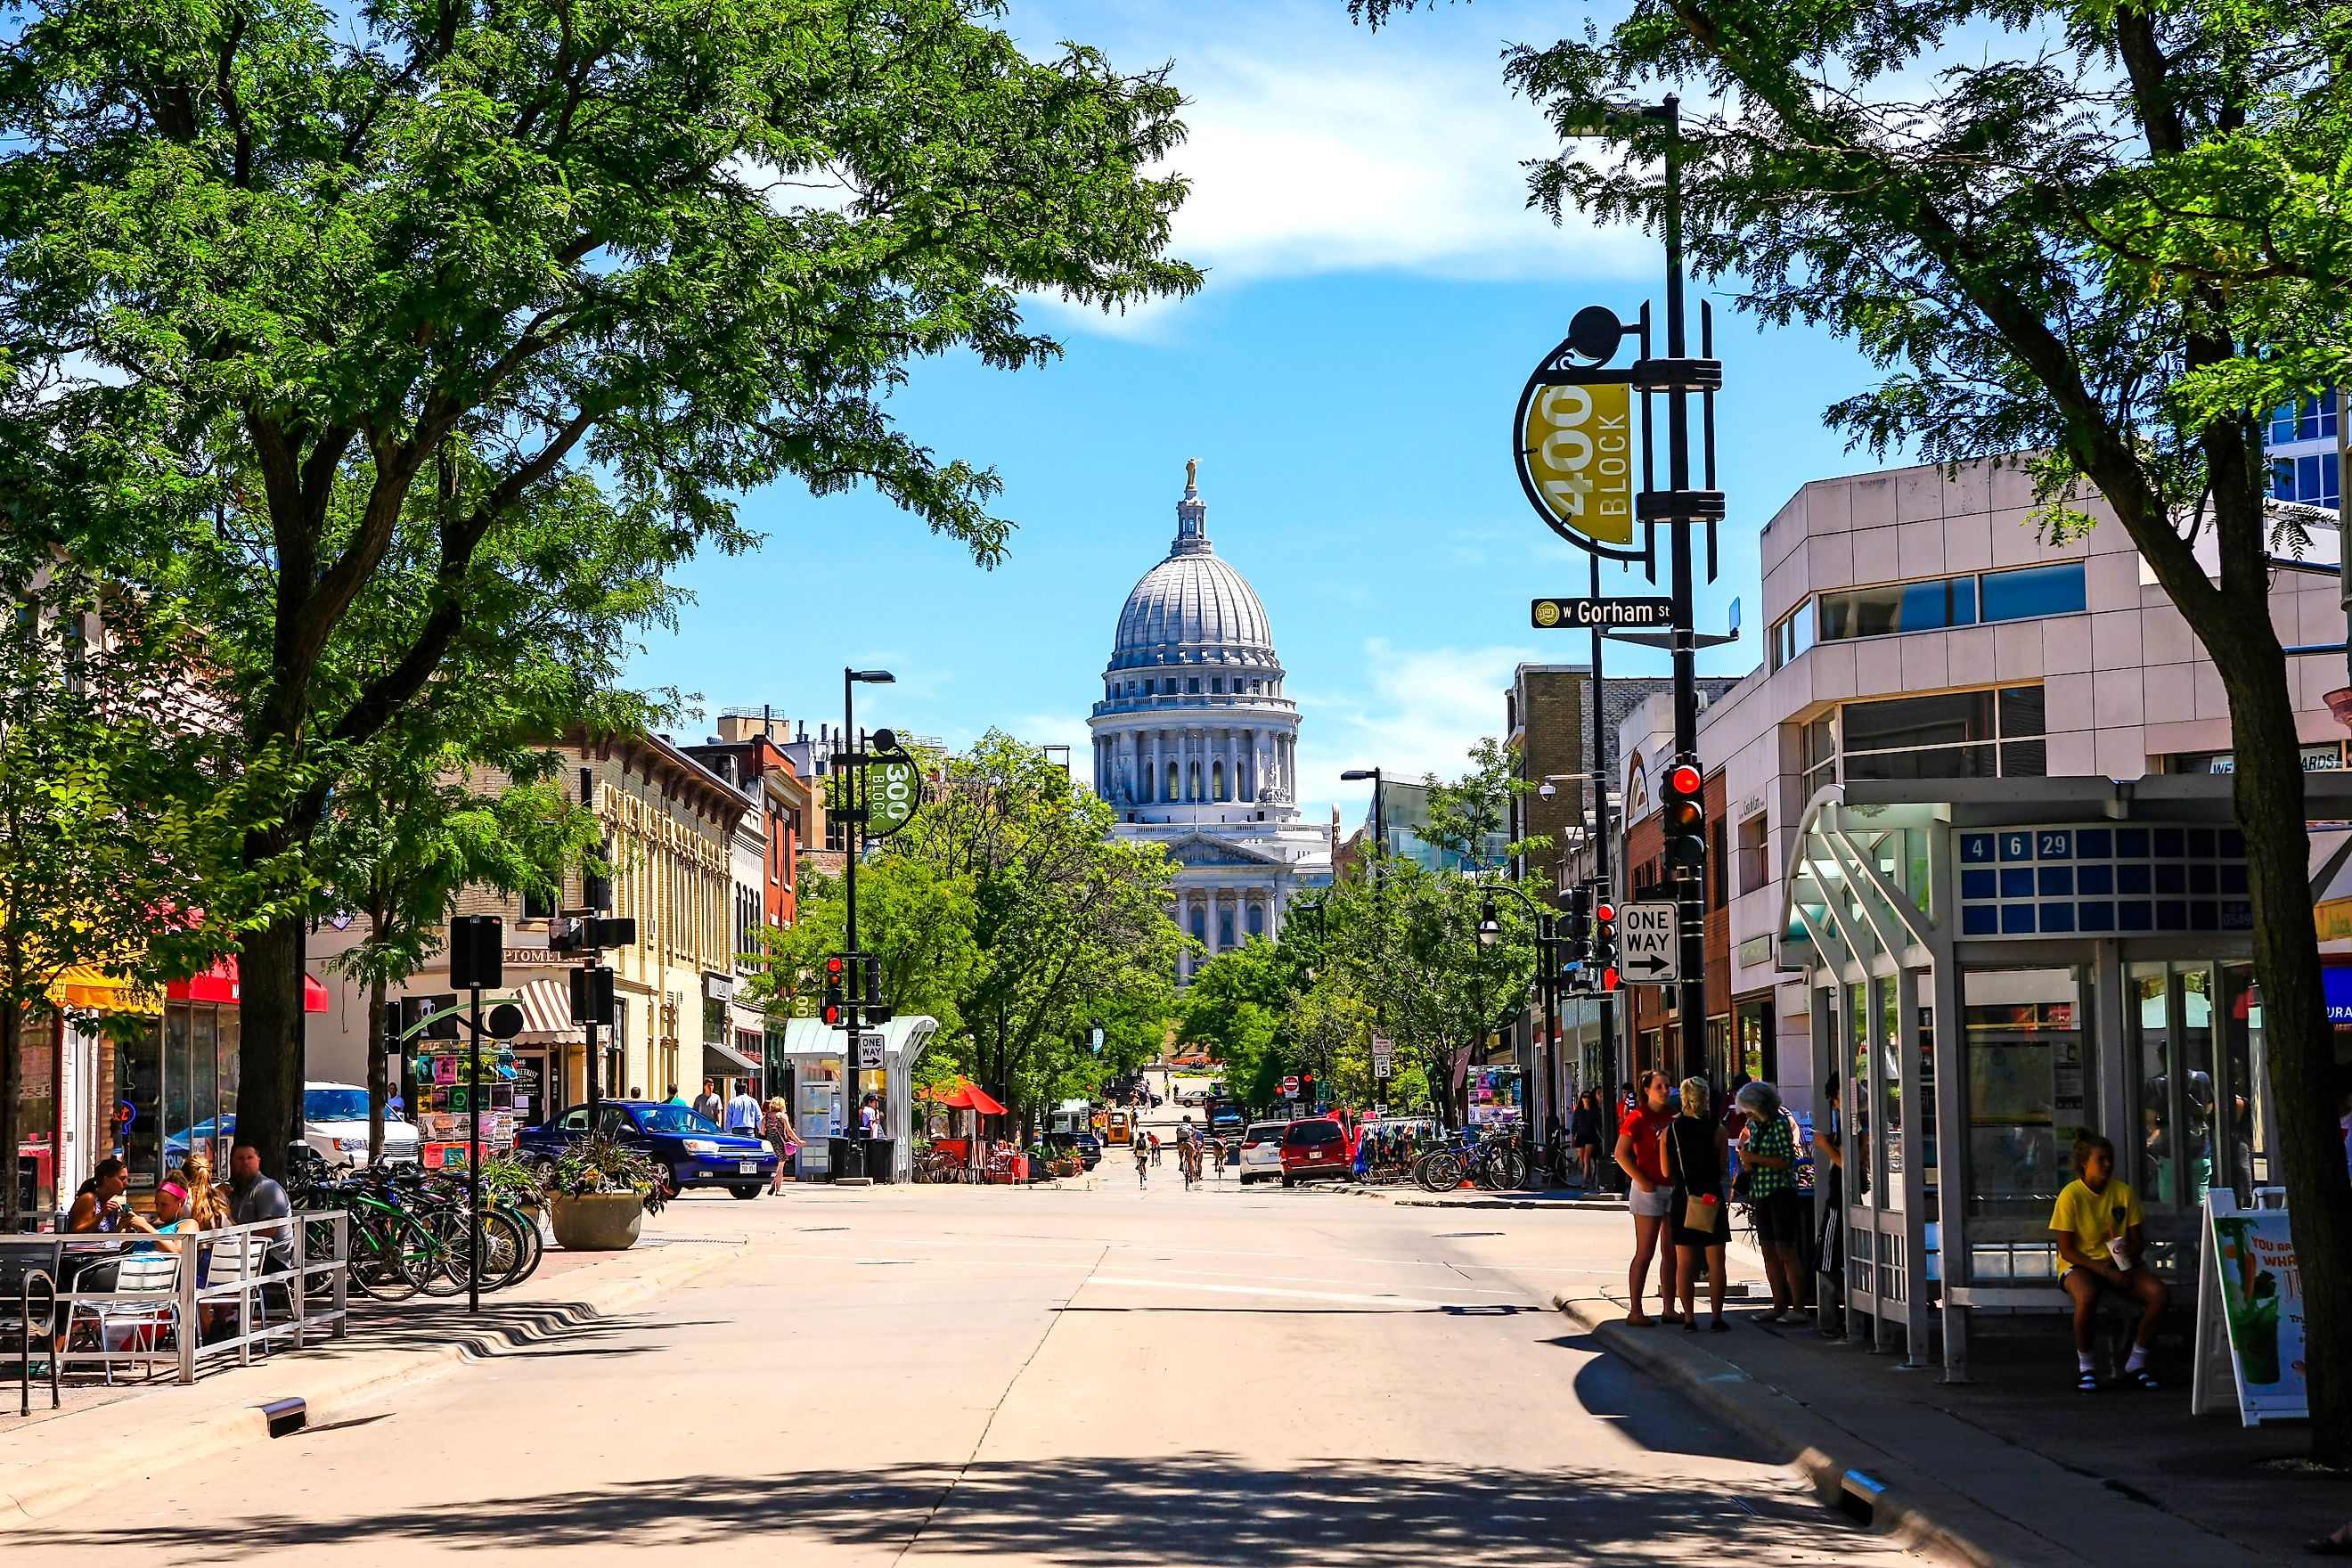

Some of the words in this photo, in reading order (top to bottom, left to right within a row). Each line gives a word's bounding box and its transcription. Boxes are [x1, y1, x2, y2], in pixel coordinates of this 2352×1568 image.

[1541, 385, 1593, 516] 400
[1598, 413, 1627, 516] BLOCK
[1563, 606, 1572, 618] W
[1578, 600, 1653, 623] Gorham
[1658, 605, 1670, 617] St
[2213, 763, 2233, 773] WE
[872, 775, 885, 819] BLOCK
[886, 764, 910, 820] 300
[1972, 839, 1983, 857] 4
[2010, 837, 2021, 855] 6
[2042, 836, 2066, 854] 29
[1627, 911, 1669, 929] ONE
[2223, 912, 2252, 927] 0549
[1627, 933, 1670, 951] WAY
[796, 995, 809, 1017] 00
[809, 1002, 817, 1018] OCK
[862, 1038, 881, 1047] ONE
[862, 1048, 881, 1057] WAY
[1376, 1066, 1388, 1076] 15
[2251, 1236, 2274, 1252] YOU
[2277, 1241, 2293, 1251] AR
[2263, 1254, 2298, 1267] WHA
